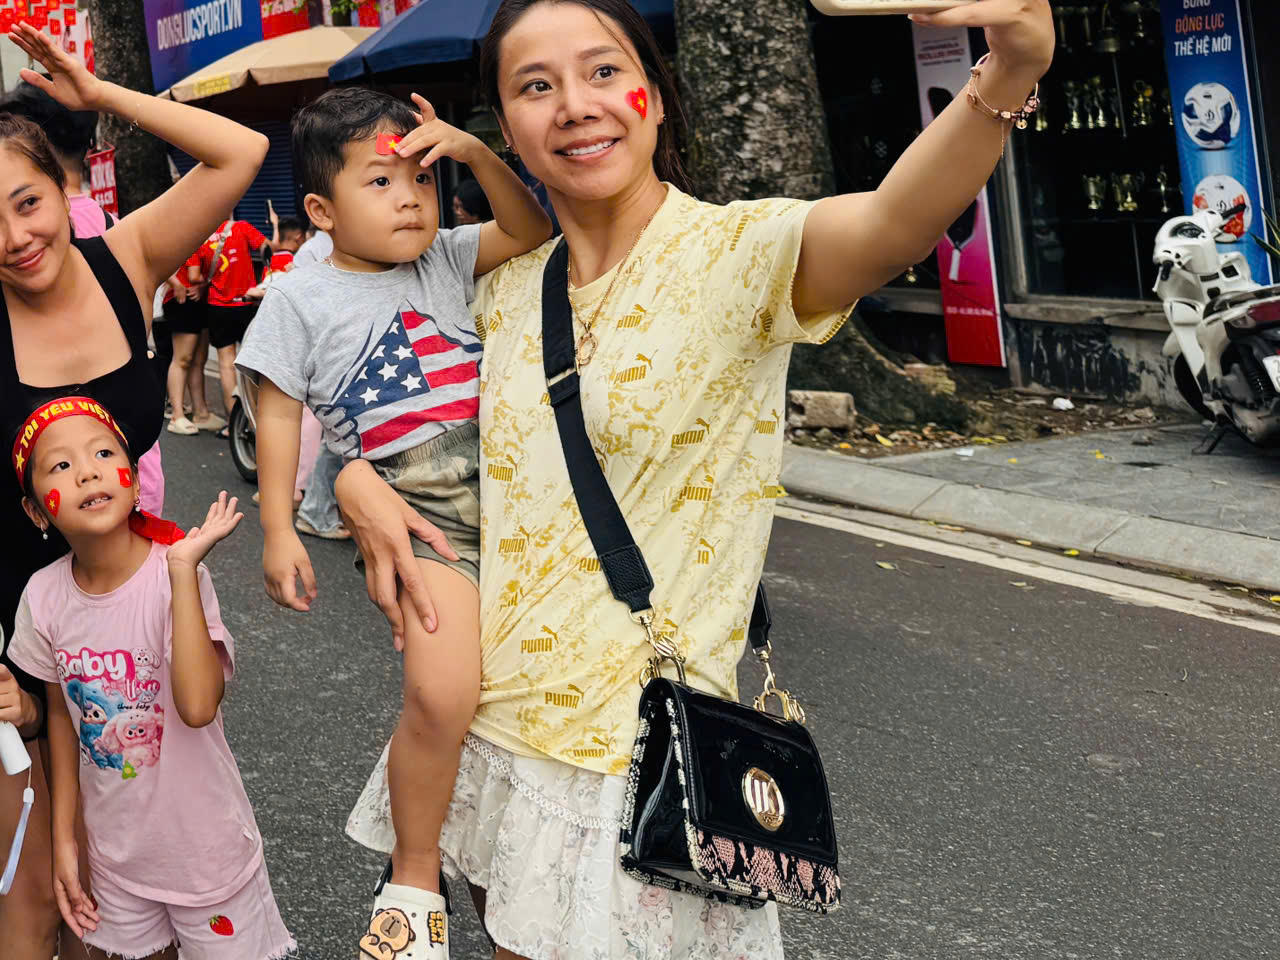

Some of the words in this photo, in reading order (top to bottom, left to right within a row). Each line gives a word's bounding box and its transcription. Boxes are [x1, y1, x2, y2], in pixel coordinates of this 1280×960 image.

[1175, 13, 1202, 36] ĐỘNG
[1204, 12, 1225, 32] LỰC
[1195, 34, 1210, 57] HỆ
[614, 365, 647, 385] PUMA
[753, 420, 776, 435] PUMA
[487, 463, 514, 483] PUMA
[498, 538, 526, 553] PUMA
[521, 638, 552, 654] PUMA
[544, 691, 580, 709] PUMA
